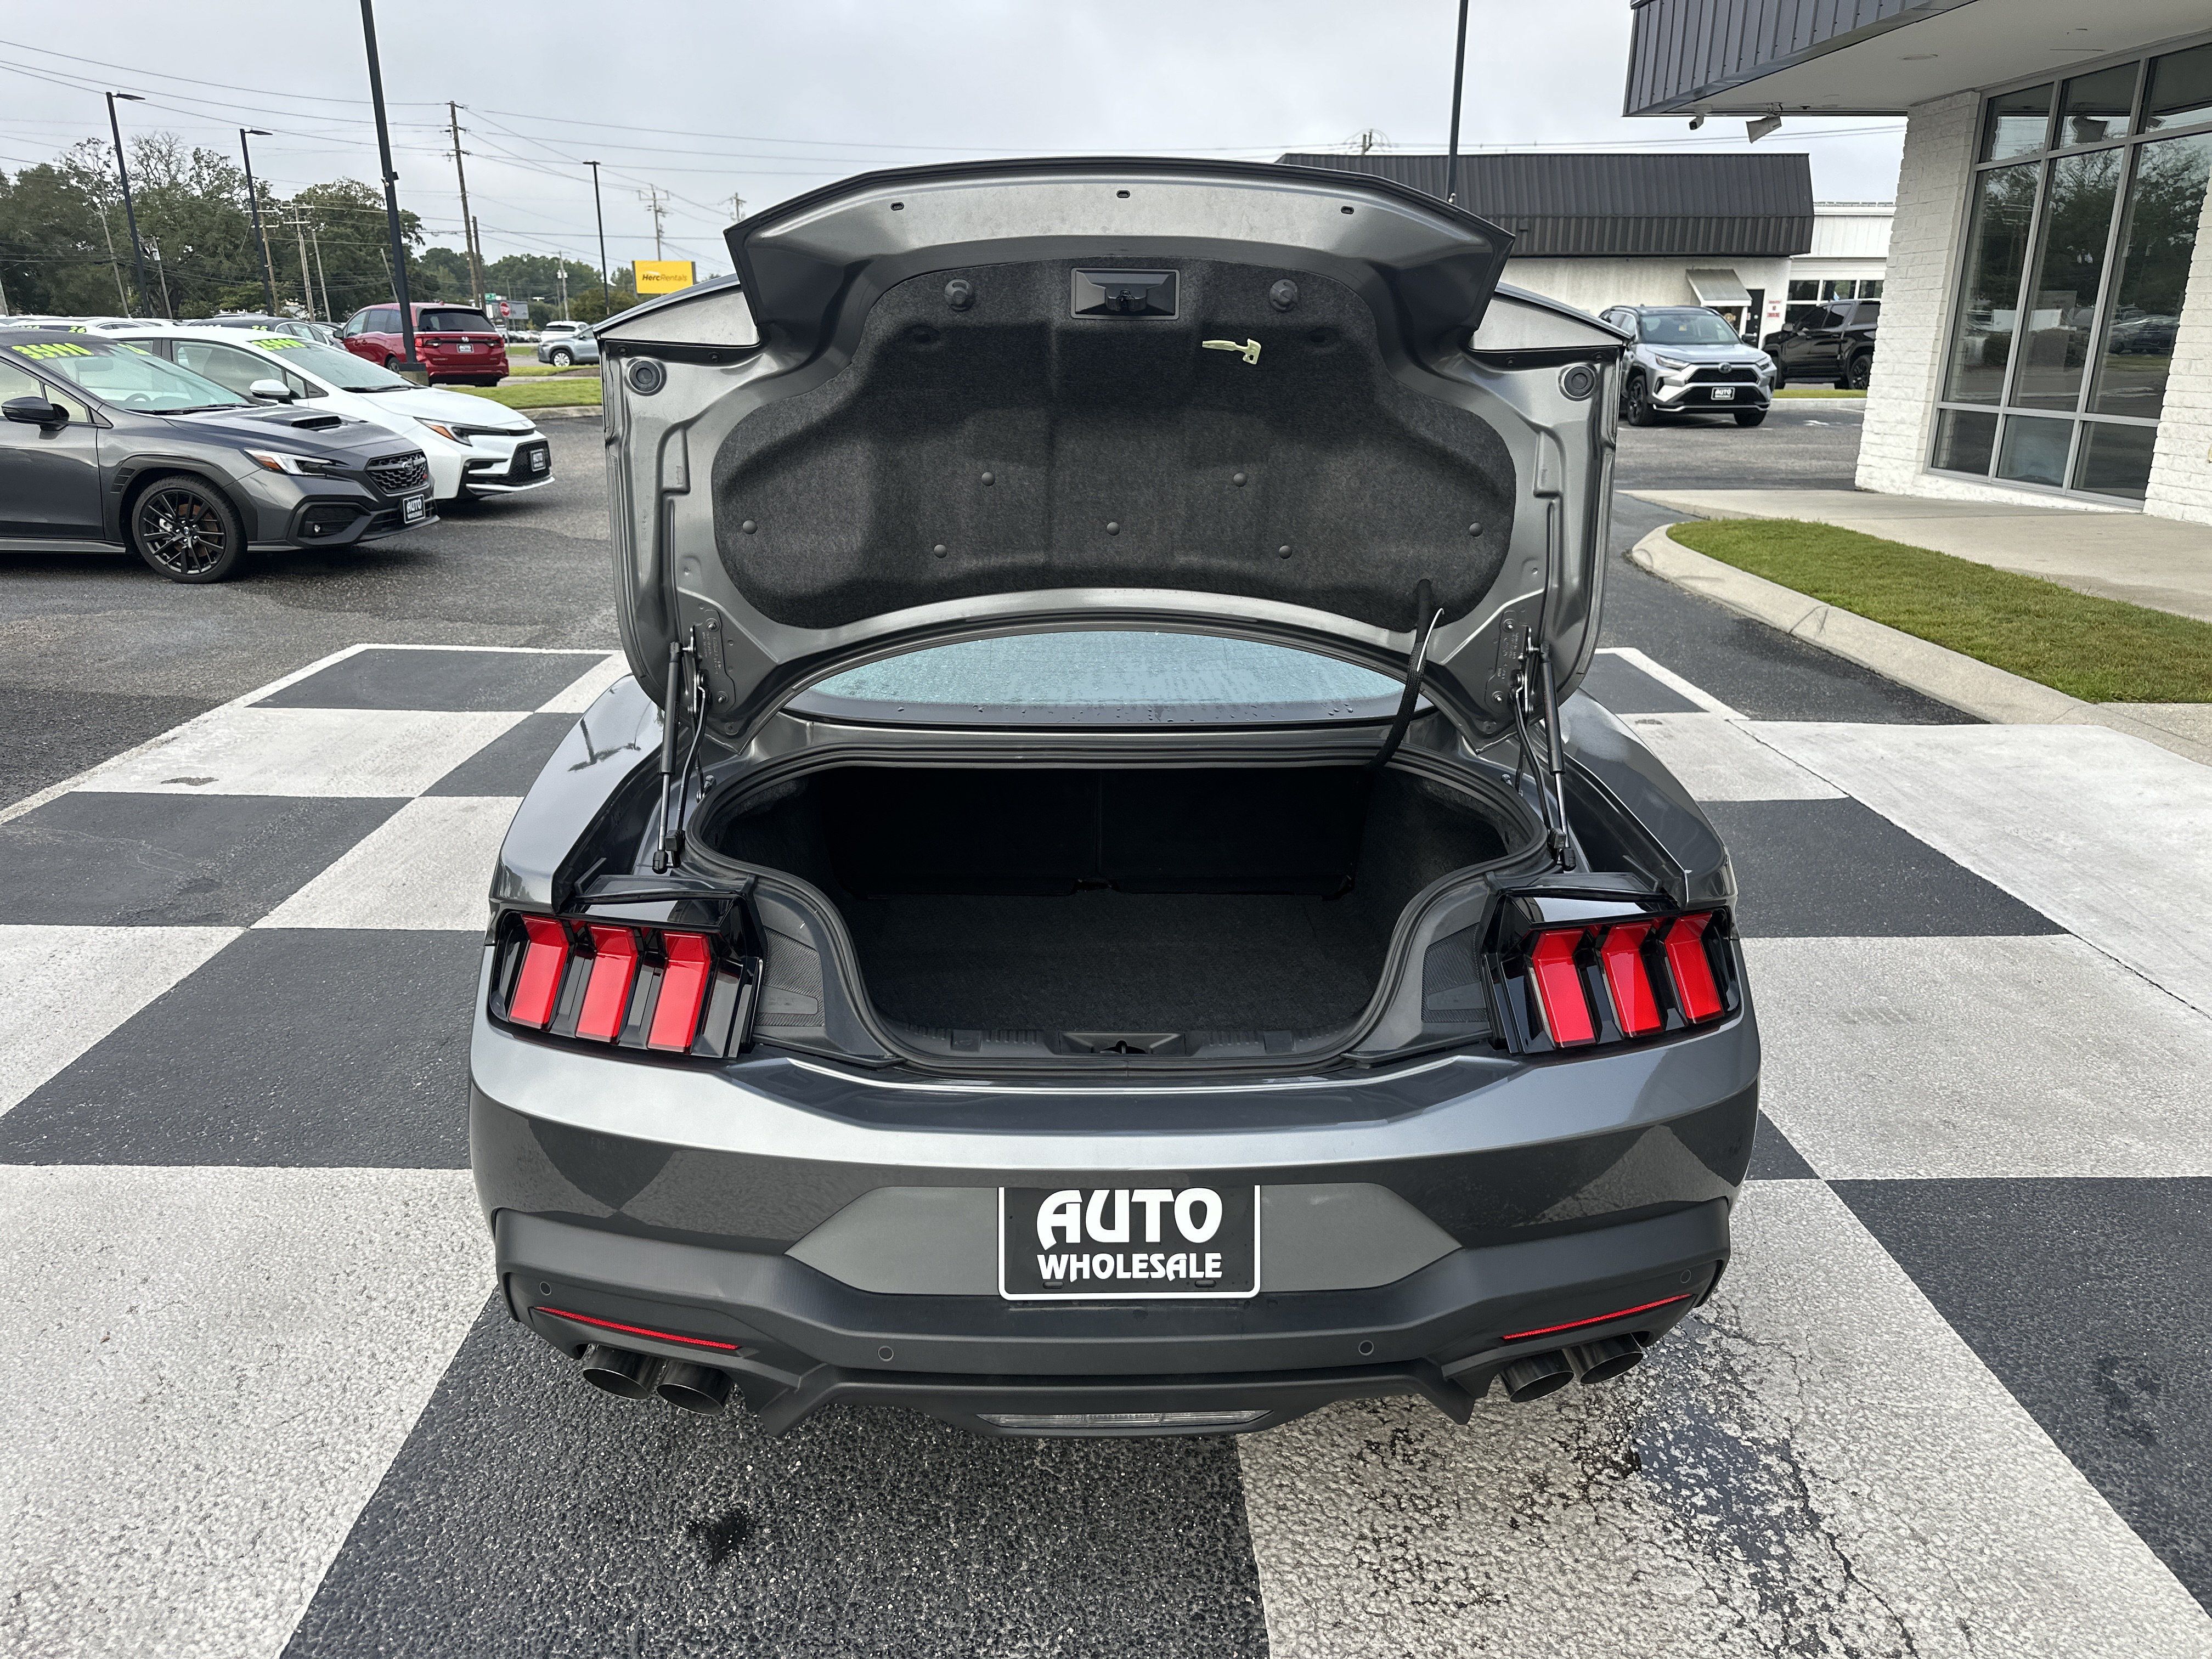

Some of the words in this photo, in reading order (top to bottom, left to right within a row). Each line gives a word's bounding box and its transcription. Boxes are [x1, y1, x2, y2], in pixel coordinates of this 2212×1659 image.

[407, 499, 422, 514] AUTO
[1036, 1188, 1222, 1250] AUTO
[1036, 1252, 1222, 1283] WHOLESALE
